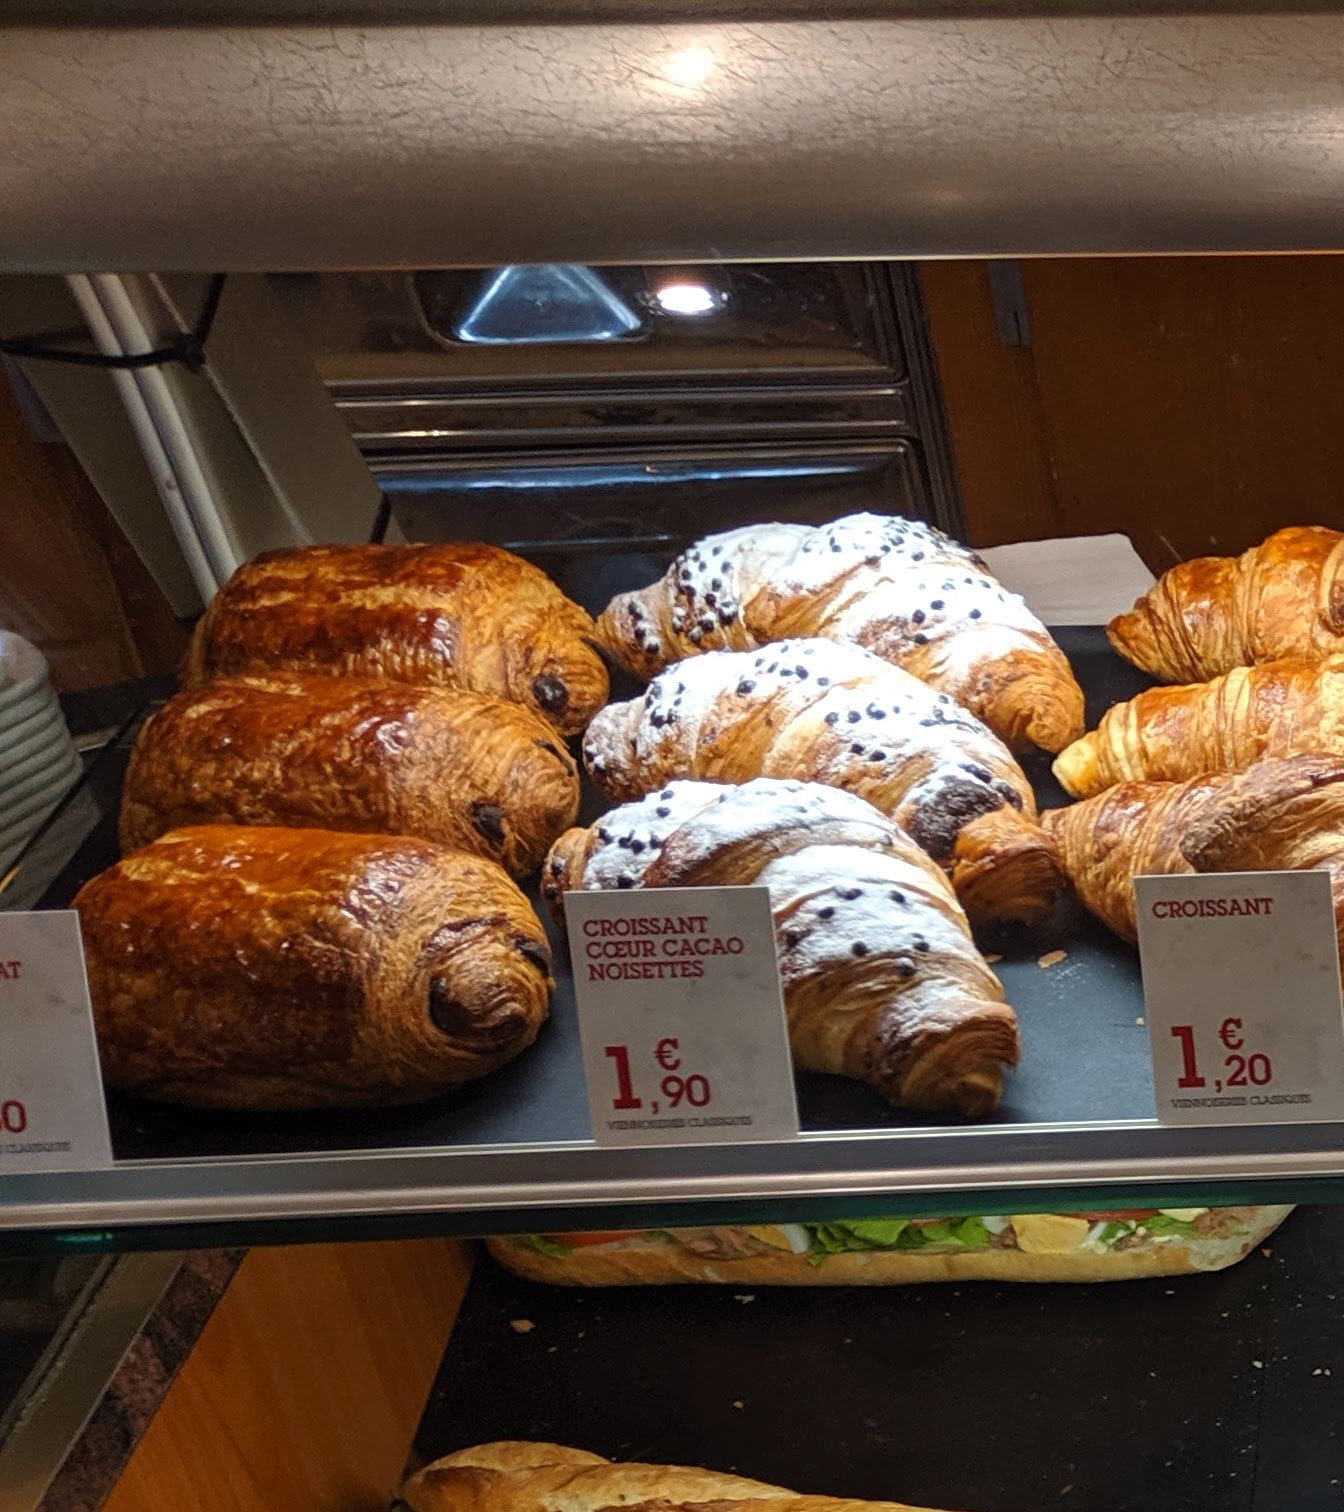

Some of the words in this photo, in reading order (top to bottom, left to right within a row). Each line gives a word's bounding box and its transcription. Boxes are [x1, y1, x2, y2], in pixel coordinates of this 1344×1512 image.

[1152, 898, 1274, 919] CROISSANT
[583, 916, 708, 937] CROISSANT
[587, 940, 657, 960] CŒUR
[663, 937, 744, 957] CACAO
[588, 961, 704, 981] NOISETTES
